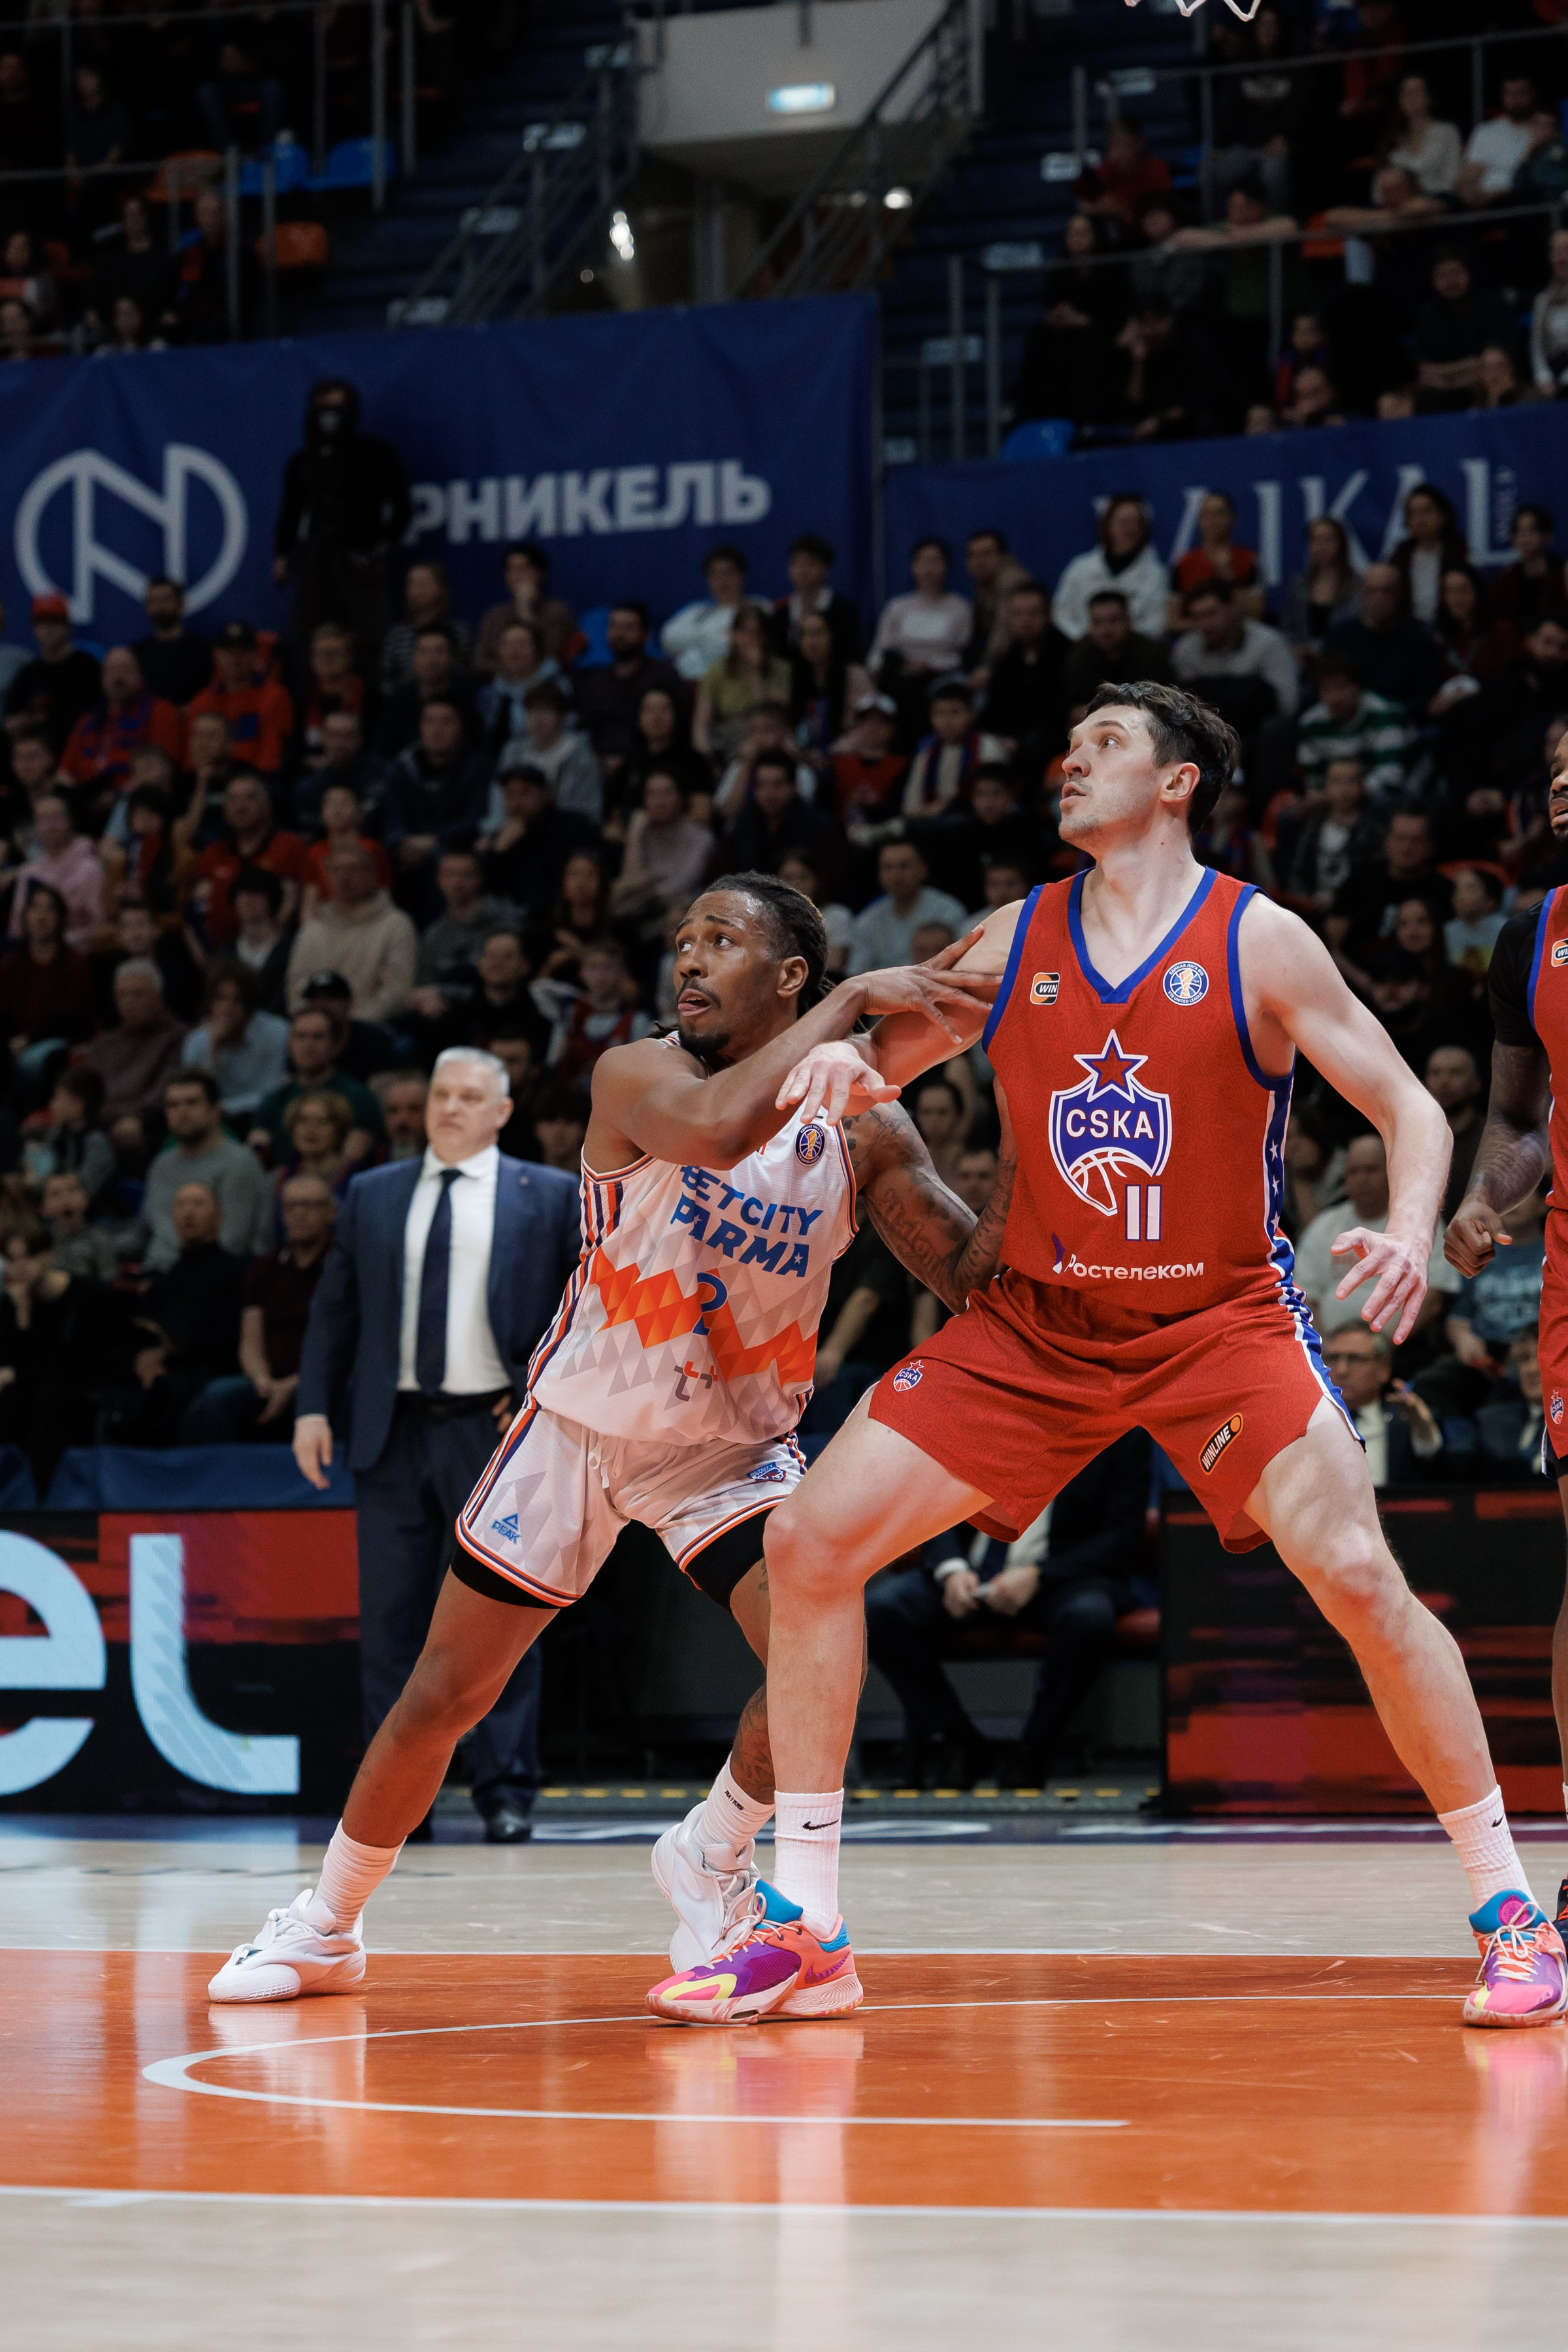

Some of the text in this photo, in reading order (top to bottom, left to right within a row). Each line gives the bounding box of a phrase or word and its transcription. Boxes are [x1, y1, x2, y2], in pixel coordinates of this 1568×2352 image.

[402, 460, 772, 546] РНИКЕЛЬ
[1558, 947, 1568, 958] WI
[1039, 984, 1058, 993] WIN
[1189, 991, 1203, 1003] LEAGUE
[1066, 1109, 1155, 1139] CSKA
[1125, 1184, 1162, 1241] 11
[670, 1191, 809, 1277] PARMA
[1064, 1253, 1203, 1281] Ростелеком
[692, 1272, 728, 1336] 2
[899, 1371, 918, 1382] CSKA
[1202, 1425, 1231, 1470] WINLINE
[491, 1519, 522, 1545] PEAK
